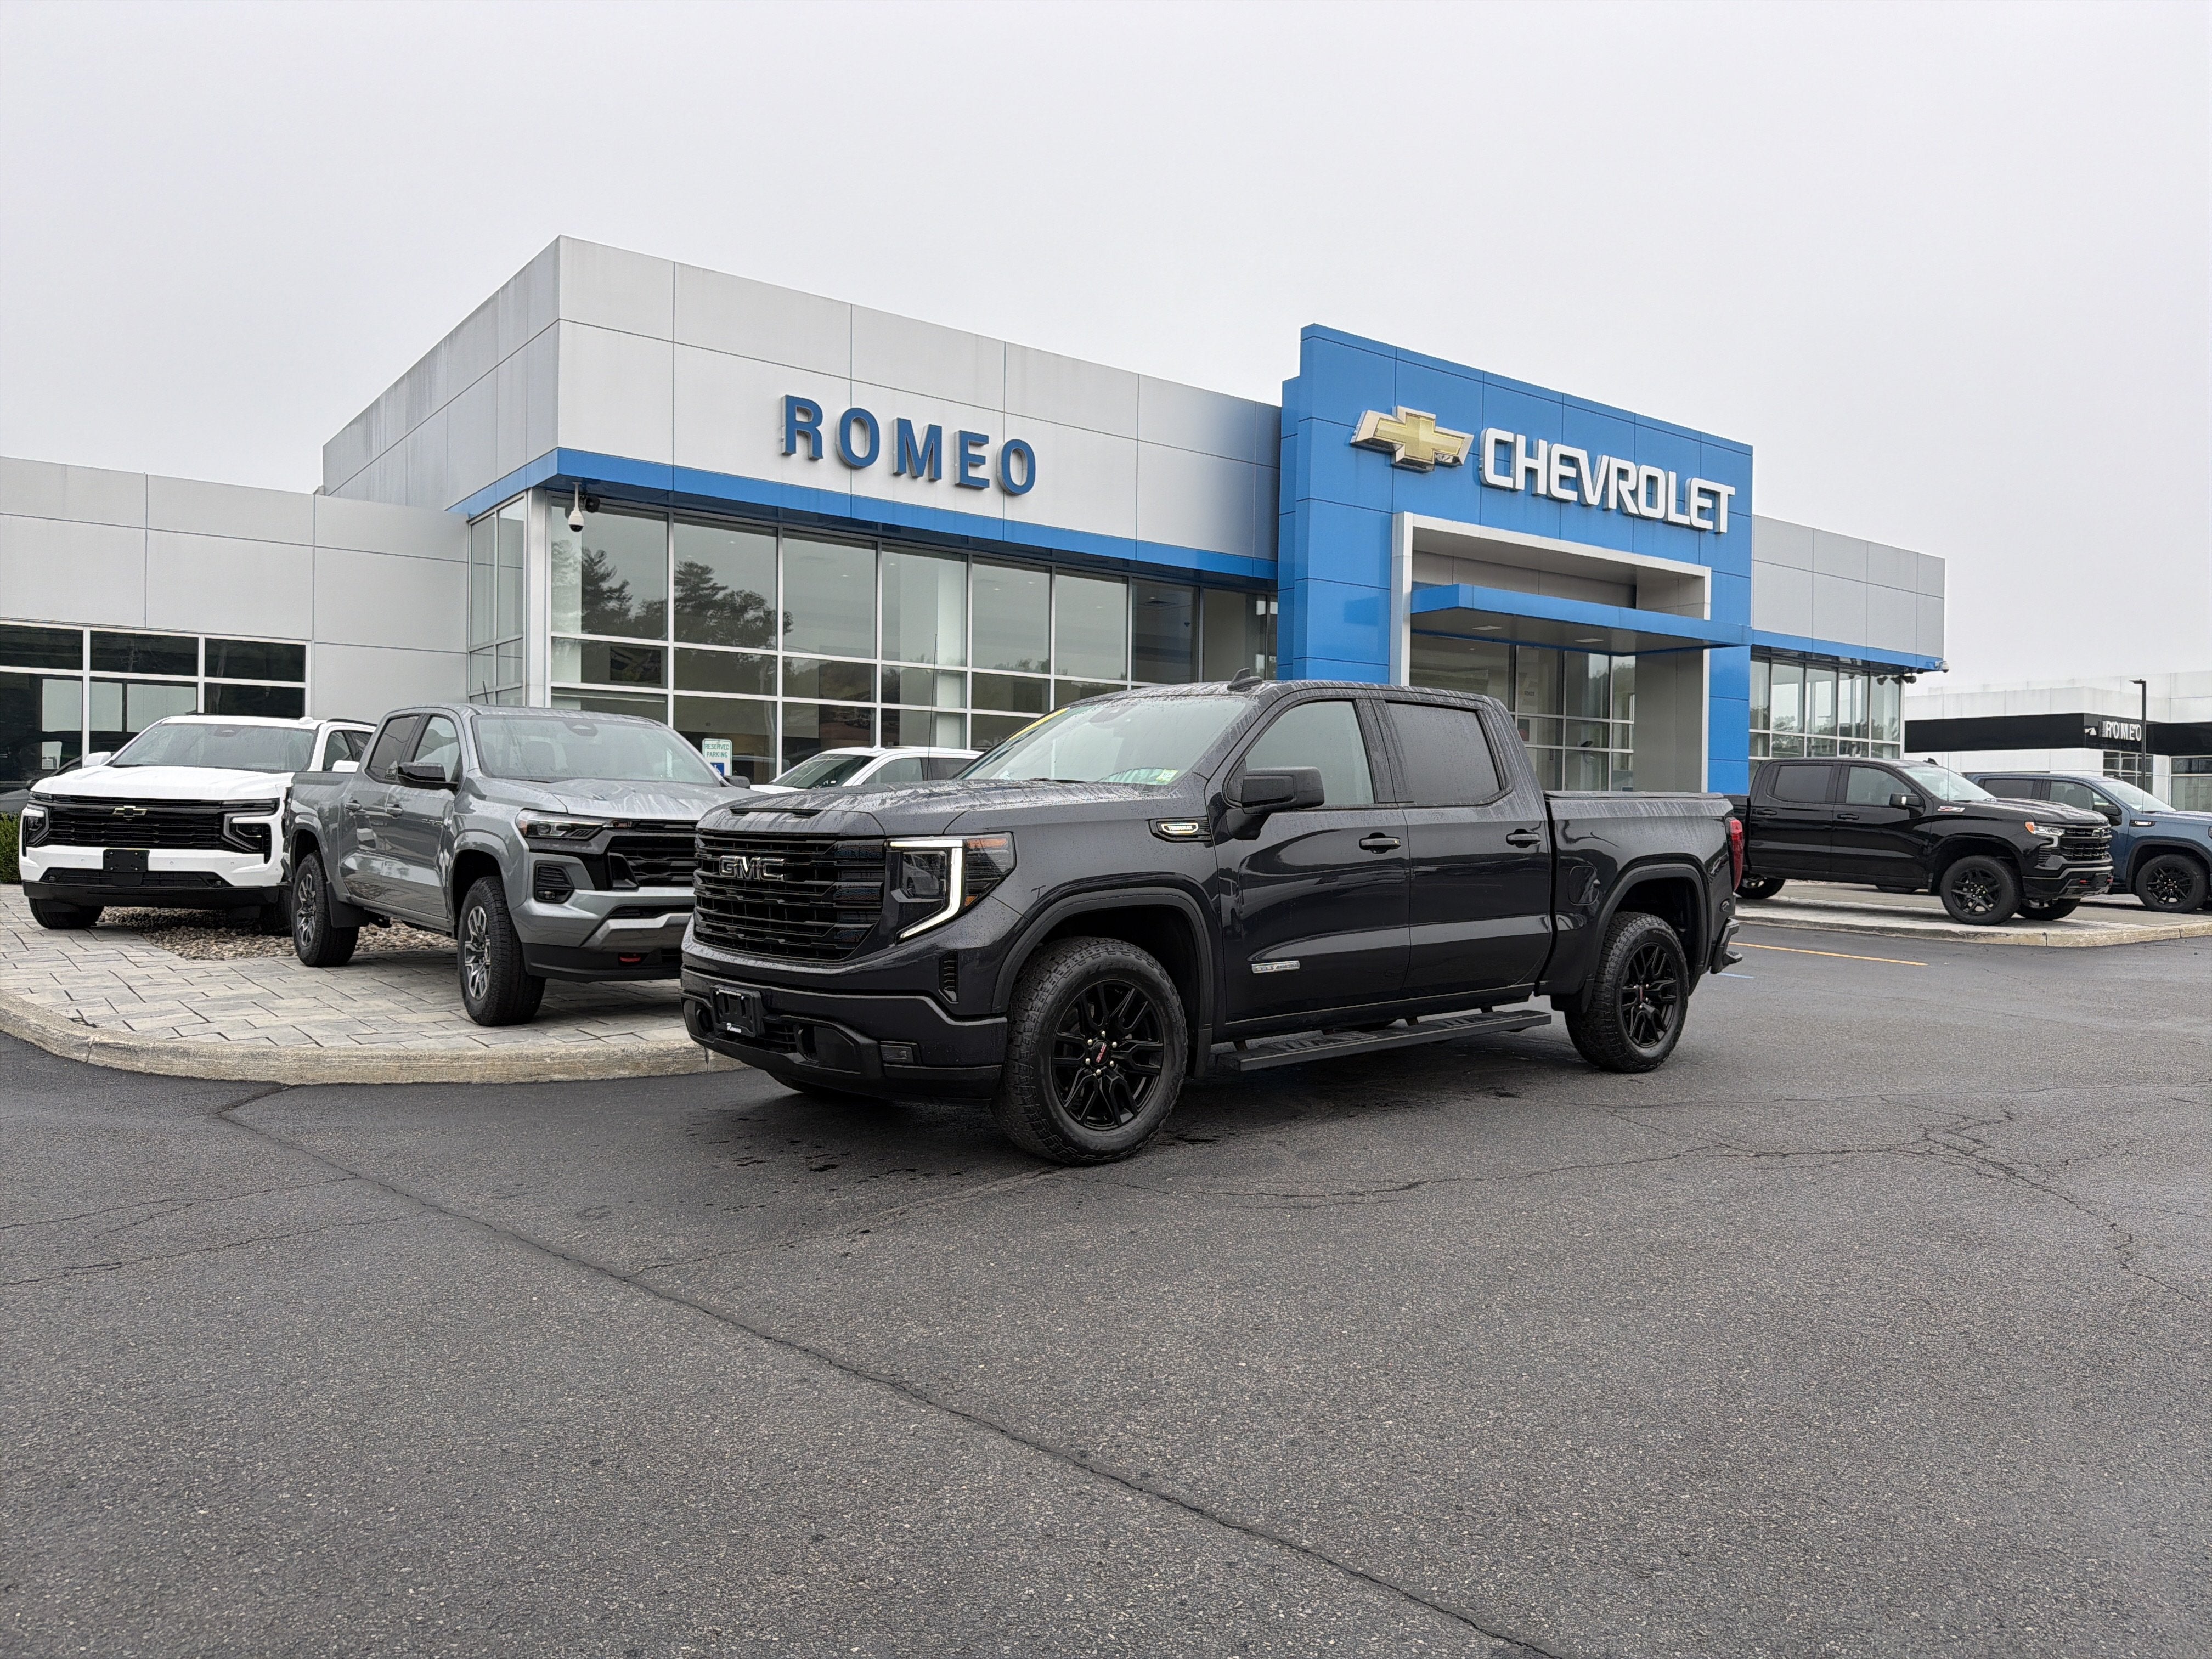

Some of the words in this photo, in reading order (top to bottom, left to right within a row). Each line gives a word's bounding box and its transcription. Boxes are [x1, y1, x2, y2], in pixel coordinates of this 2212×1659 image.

[781, 394, 1035, 494] ROMEO
[1481, 428, 1735, 533] CHEVROLET
[2102, 721, 2142, 741] ROMEO
[719, 855, 785, 882] GMC
